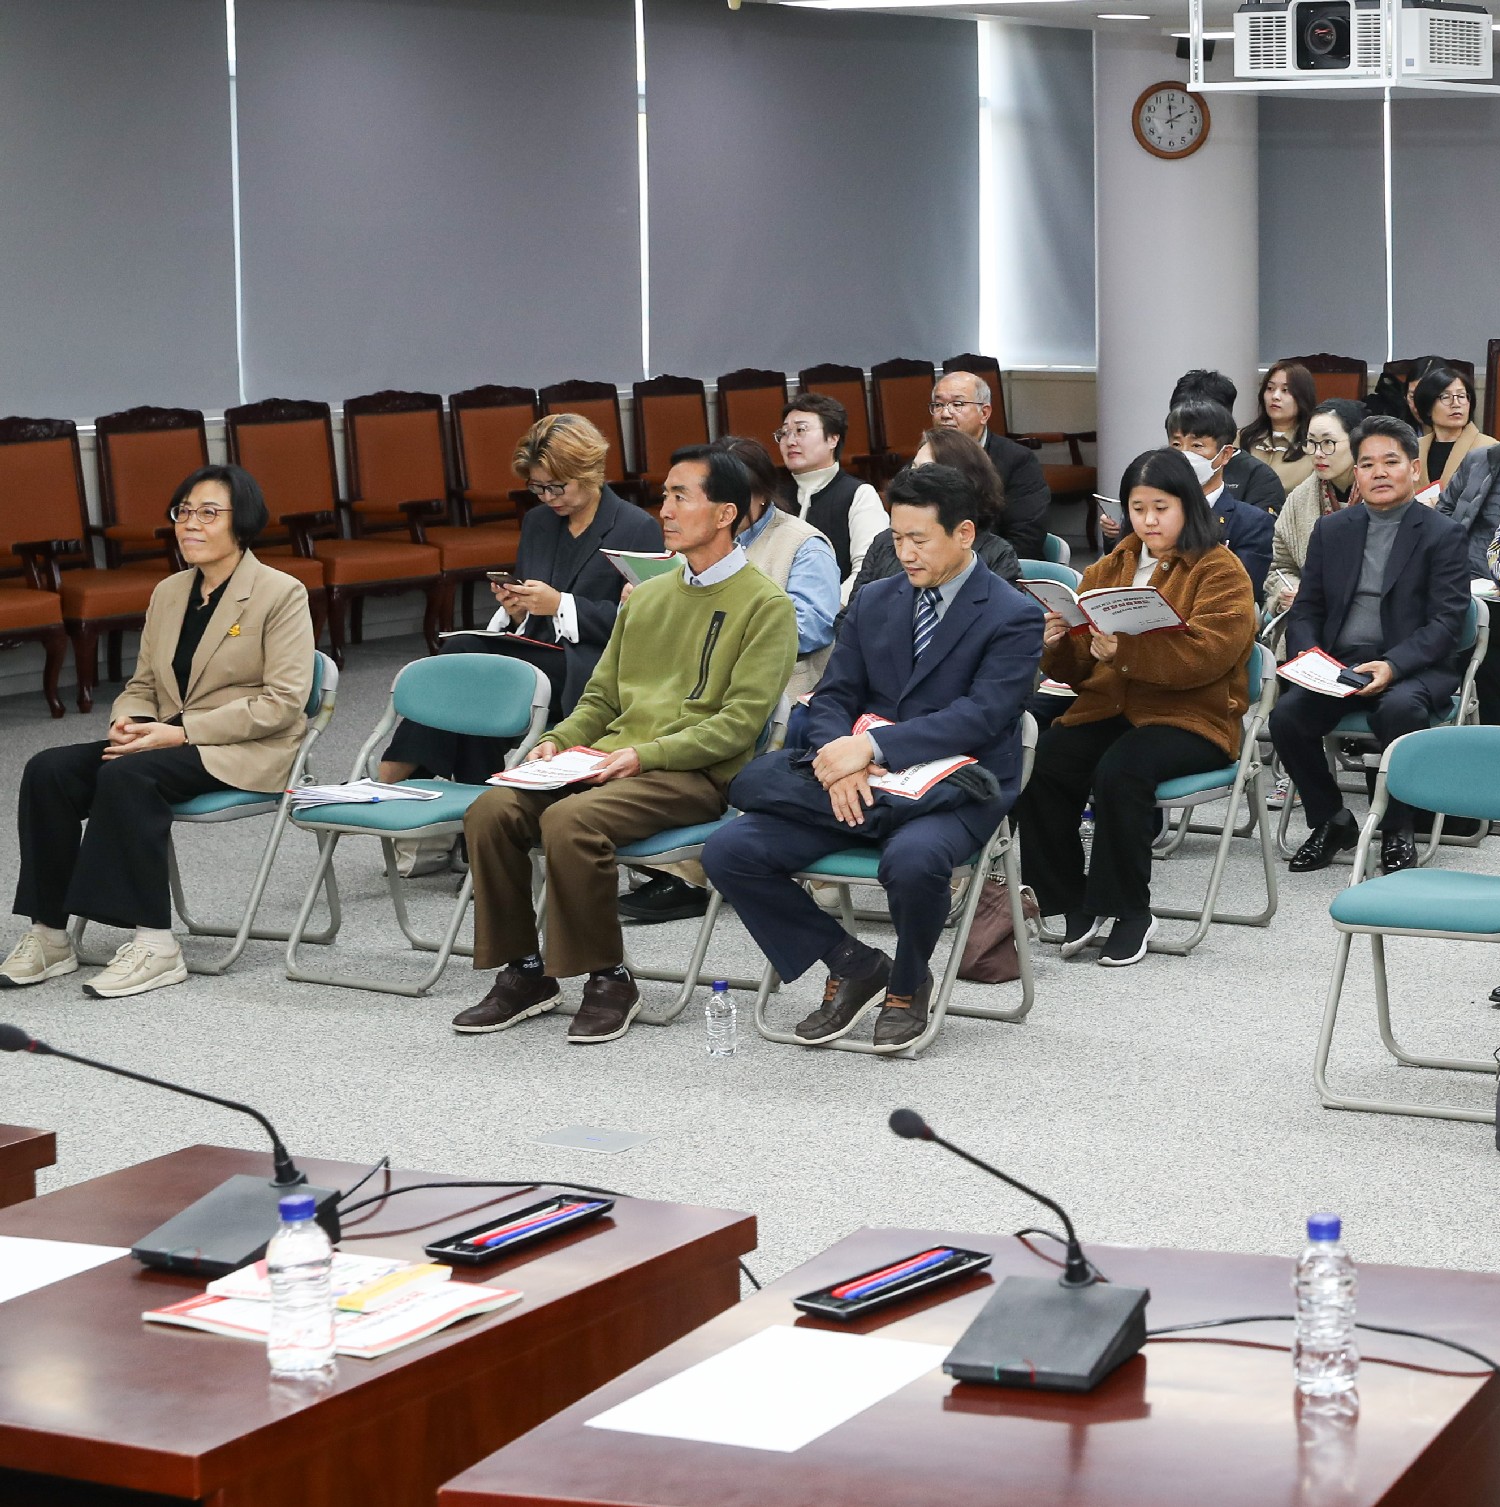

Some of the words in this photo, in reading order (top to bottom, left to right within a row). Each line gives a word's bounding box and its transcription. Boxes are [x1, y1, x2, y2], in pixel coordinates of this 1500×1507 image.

[1156, 96, 1162, 104] 11
[1167, 93, 1175, 102] 12
[1147, 105, 1156, 113] 10
[1189, 105, 1195, 113] 2
[1191, 116, 1197, 124] 3
[1149, 128, 1155, 136] 8
[1158, 136, 1162, 144] 7
[1180, 136, 1186, 144] 5
